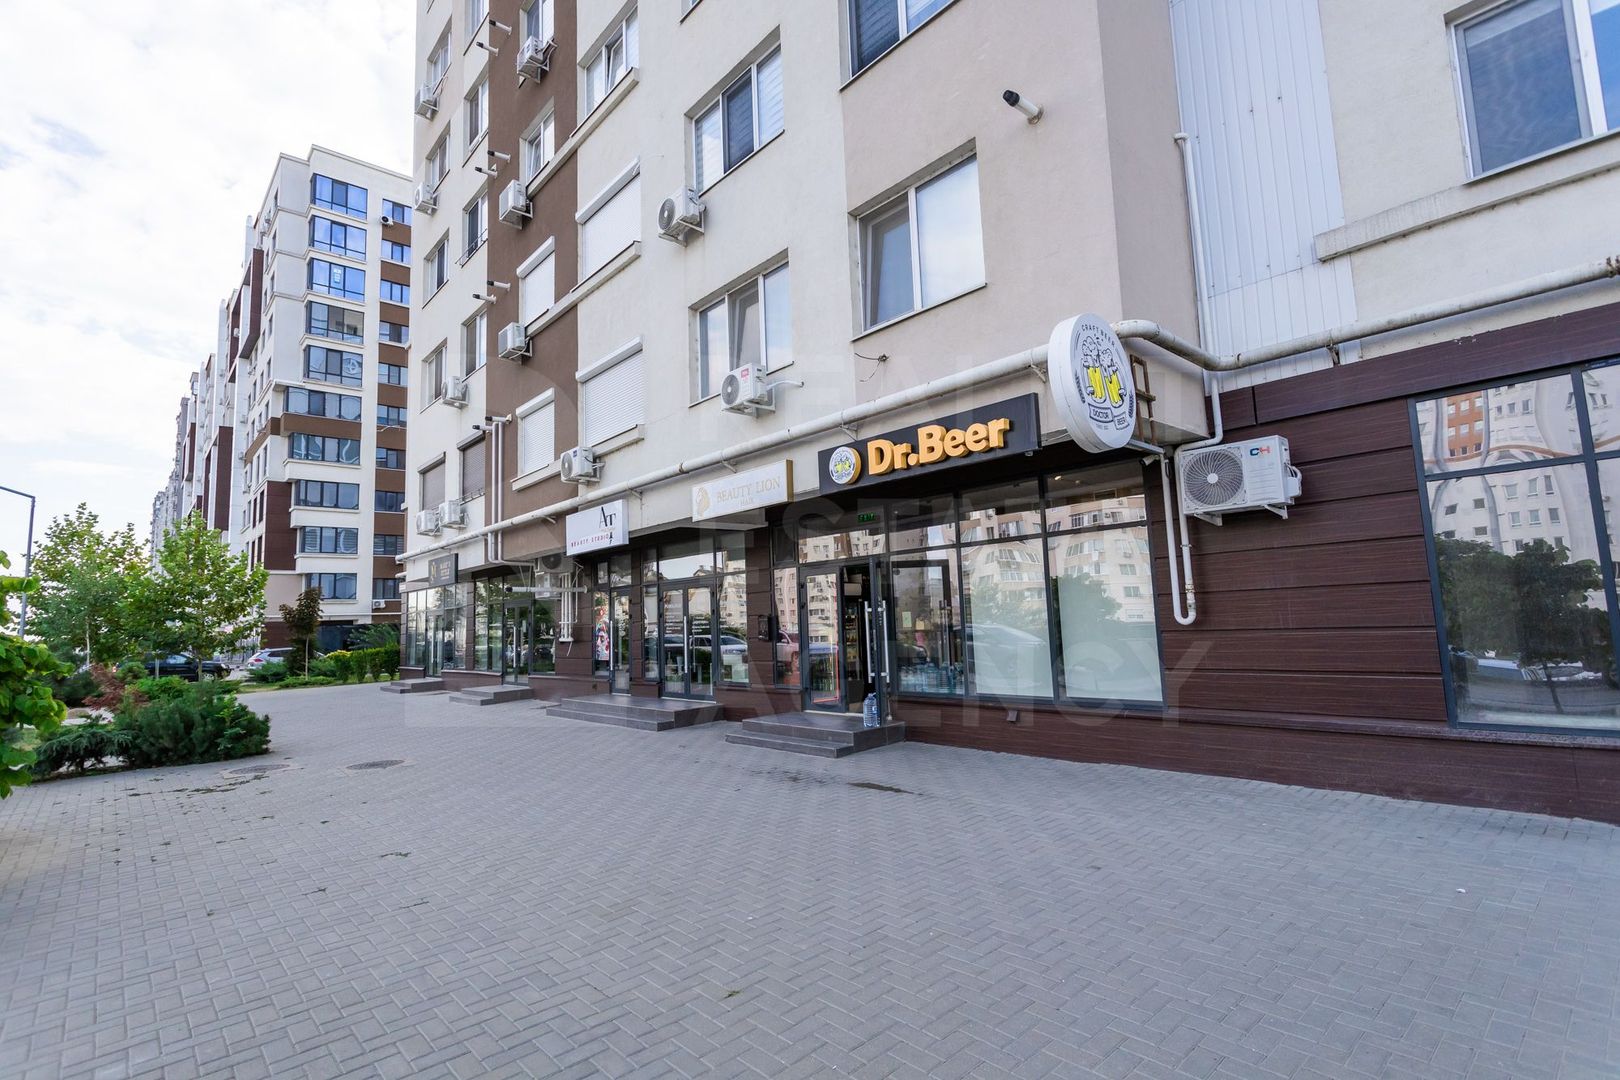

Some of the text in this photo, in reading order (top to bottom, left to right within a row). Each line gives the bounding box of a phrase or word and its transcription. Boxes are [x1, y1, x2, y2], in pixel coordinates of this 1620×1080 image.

[867, 417, 1010, 476] Dr.Beer
[716, 476, 781, 502] BEAUTY LION
